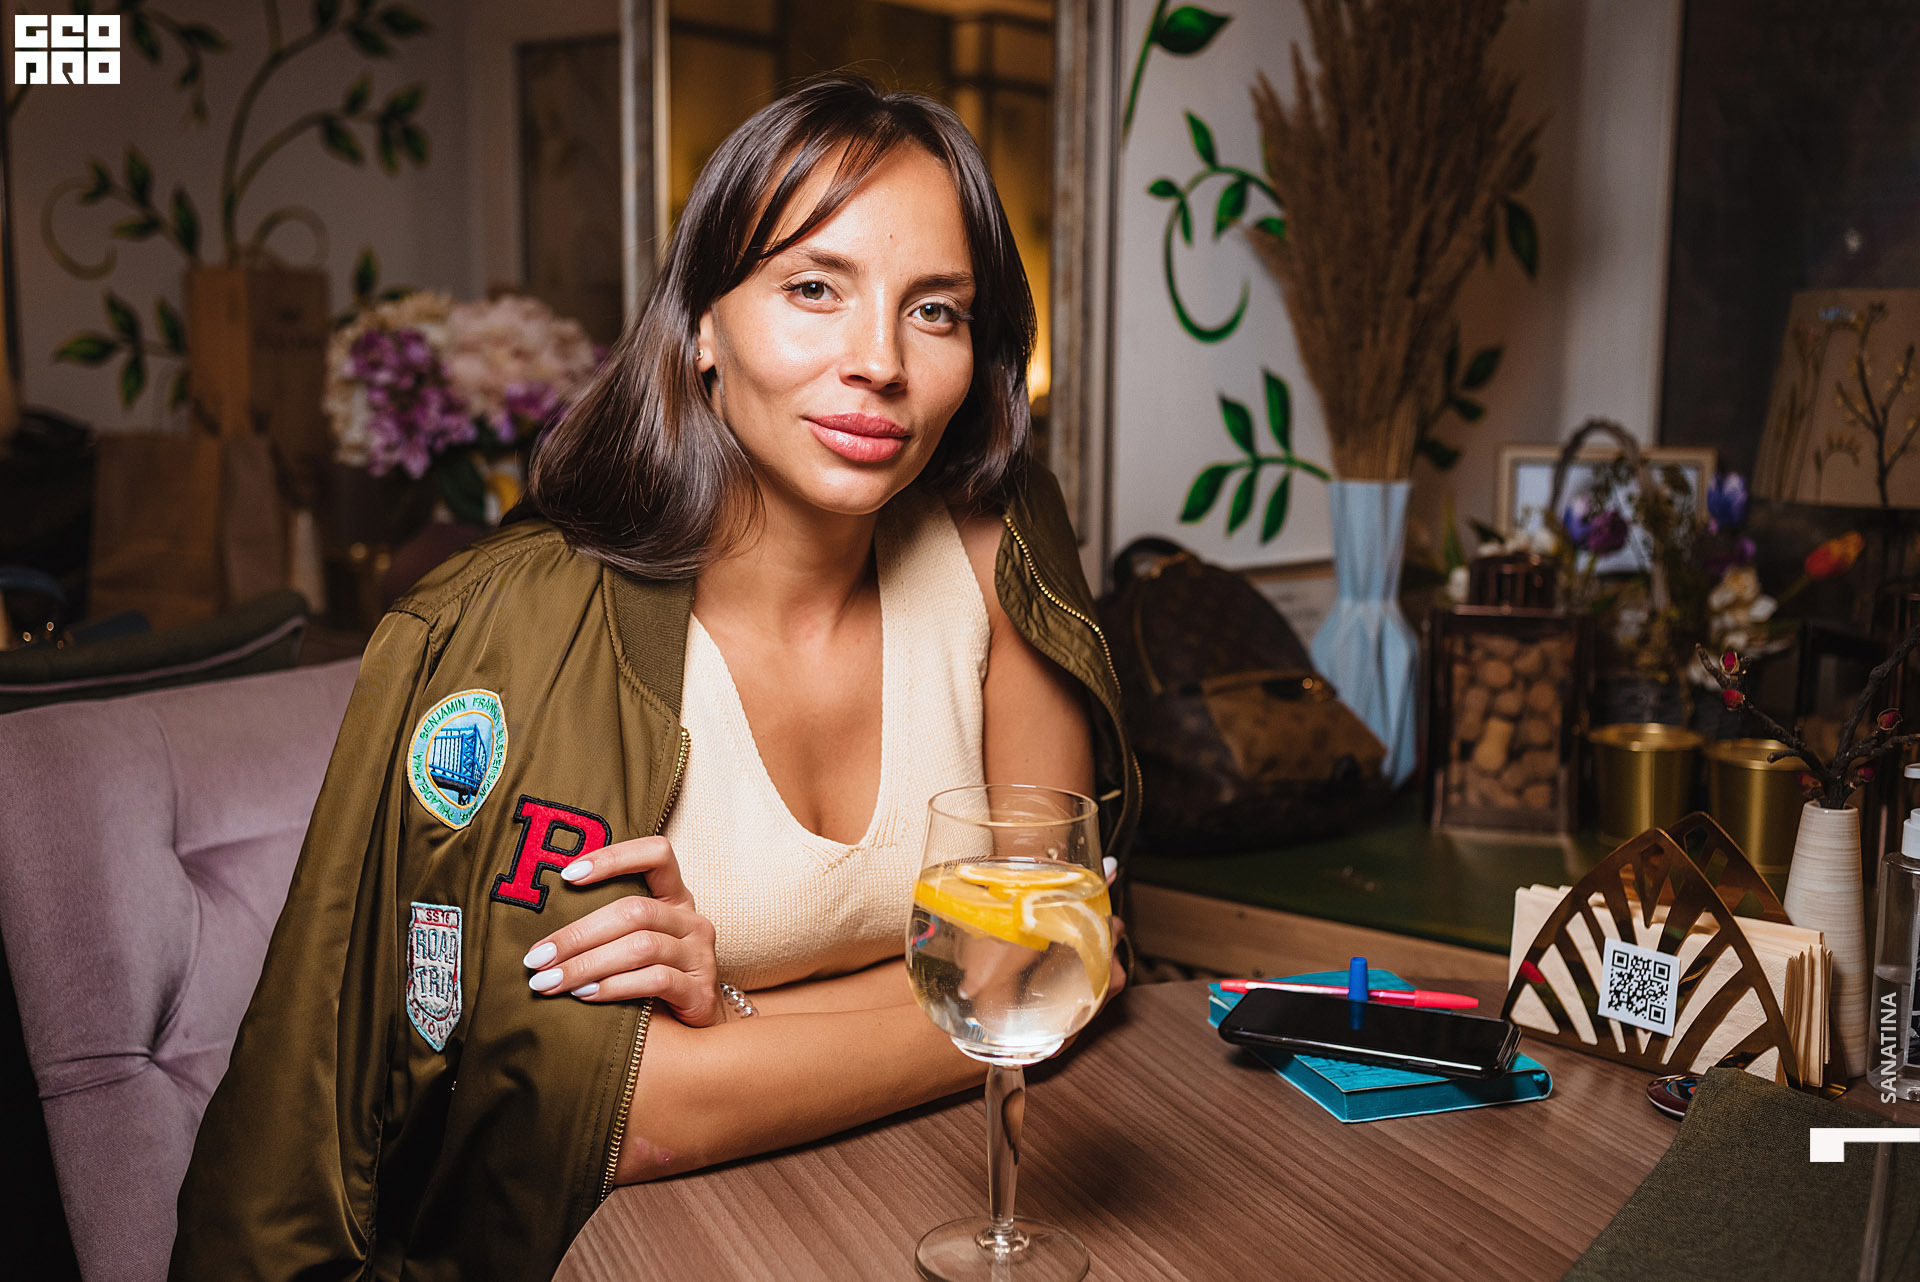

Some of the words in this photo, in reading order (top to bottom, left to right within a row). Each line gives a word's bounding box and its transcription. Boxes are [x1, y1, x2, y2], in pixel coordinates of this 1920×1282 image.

[419, 698, 466, 742] BENJAMIN
[490, 794, 612, 913] P
[415, 926, 457, 964] ROAD
